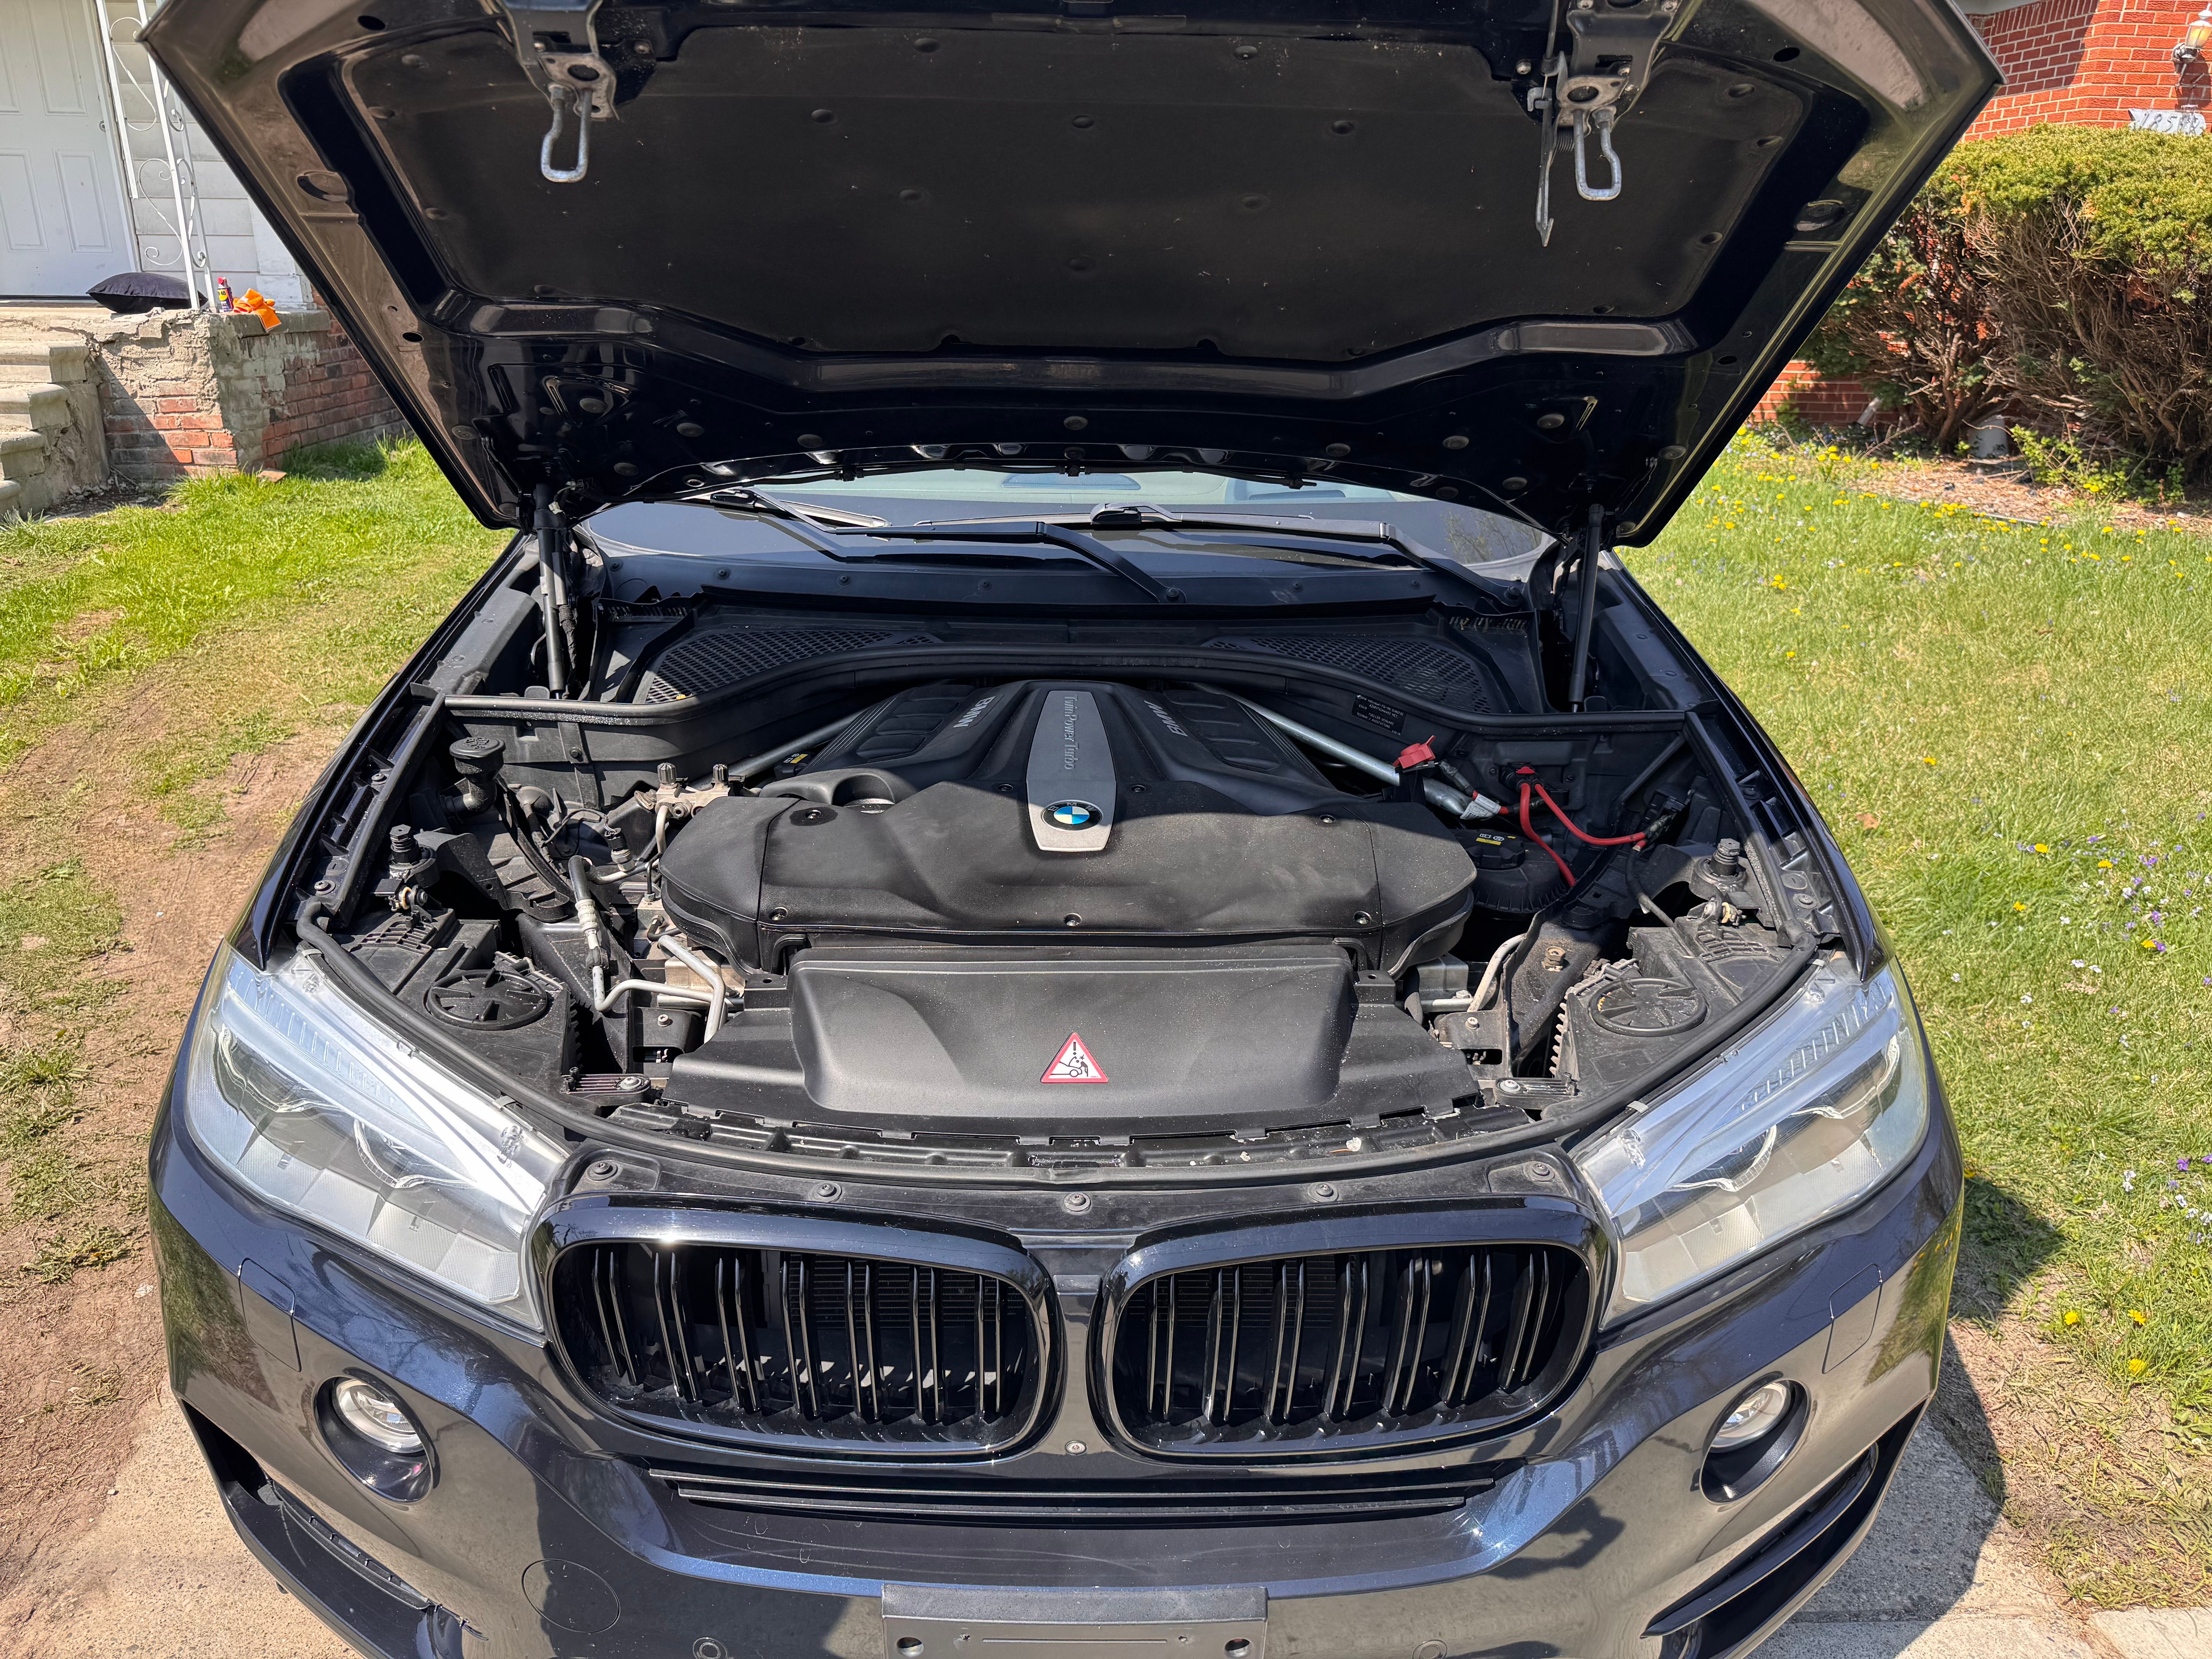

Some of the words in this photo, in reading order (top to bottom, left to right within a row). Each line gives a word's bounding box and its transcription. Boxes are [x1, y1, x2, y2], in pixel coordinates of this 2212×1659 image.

[953, 696, 996, 728] BMW
[1065, 694, 1078, 742] TwinPower
[1144, 700, 1188, 737] BMW
[1065, 742, 1079, 769] Turbo
[1048, 802, 1097, 811] BMW
